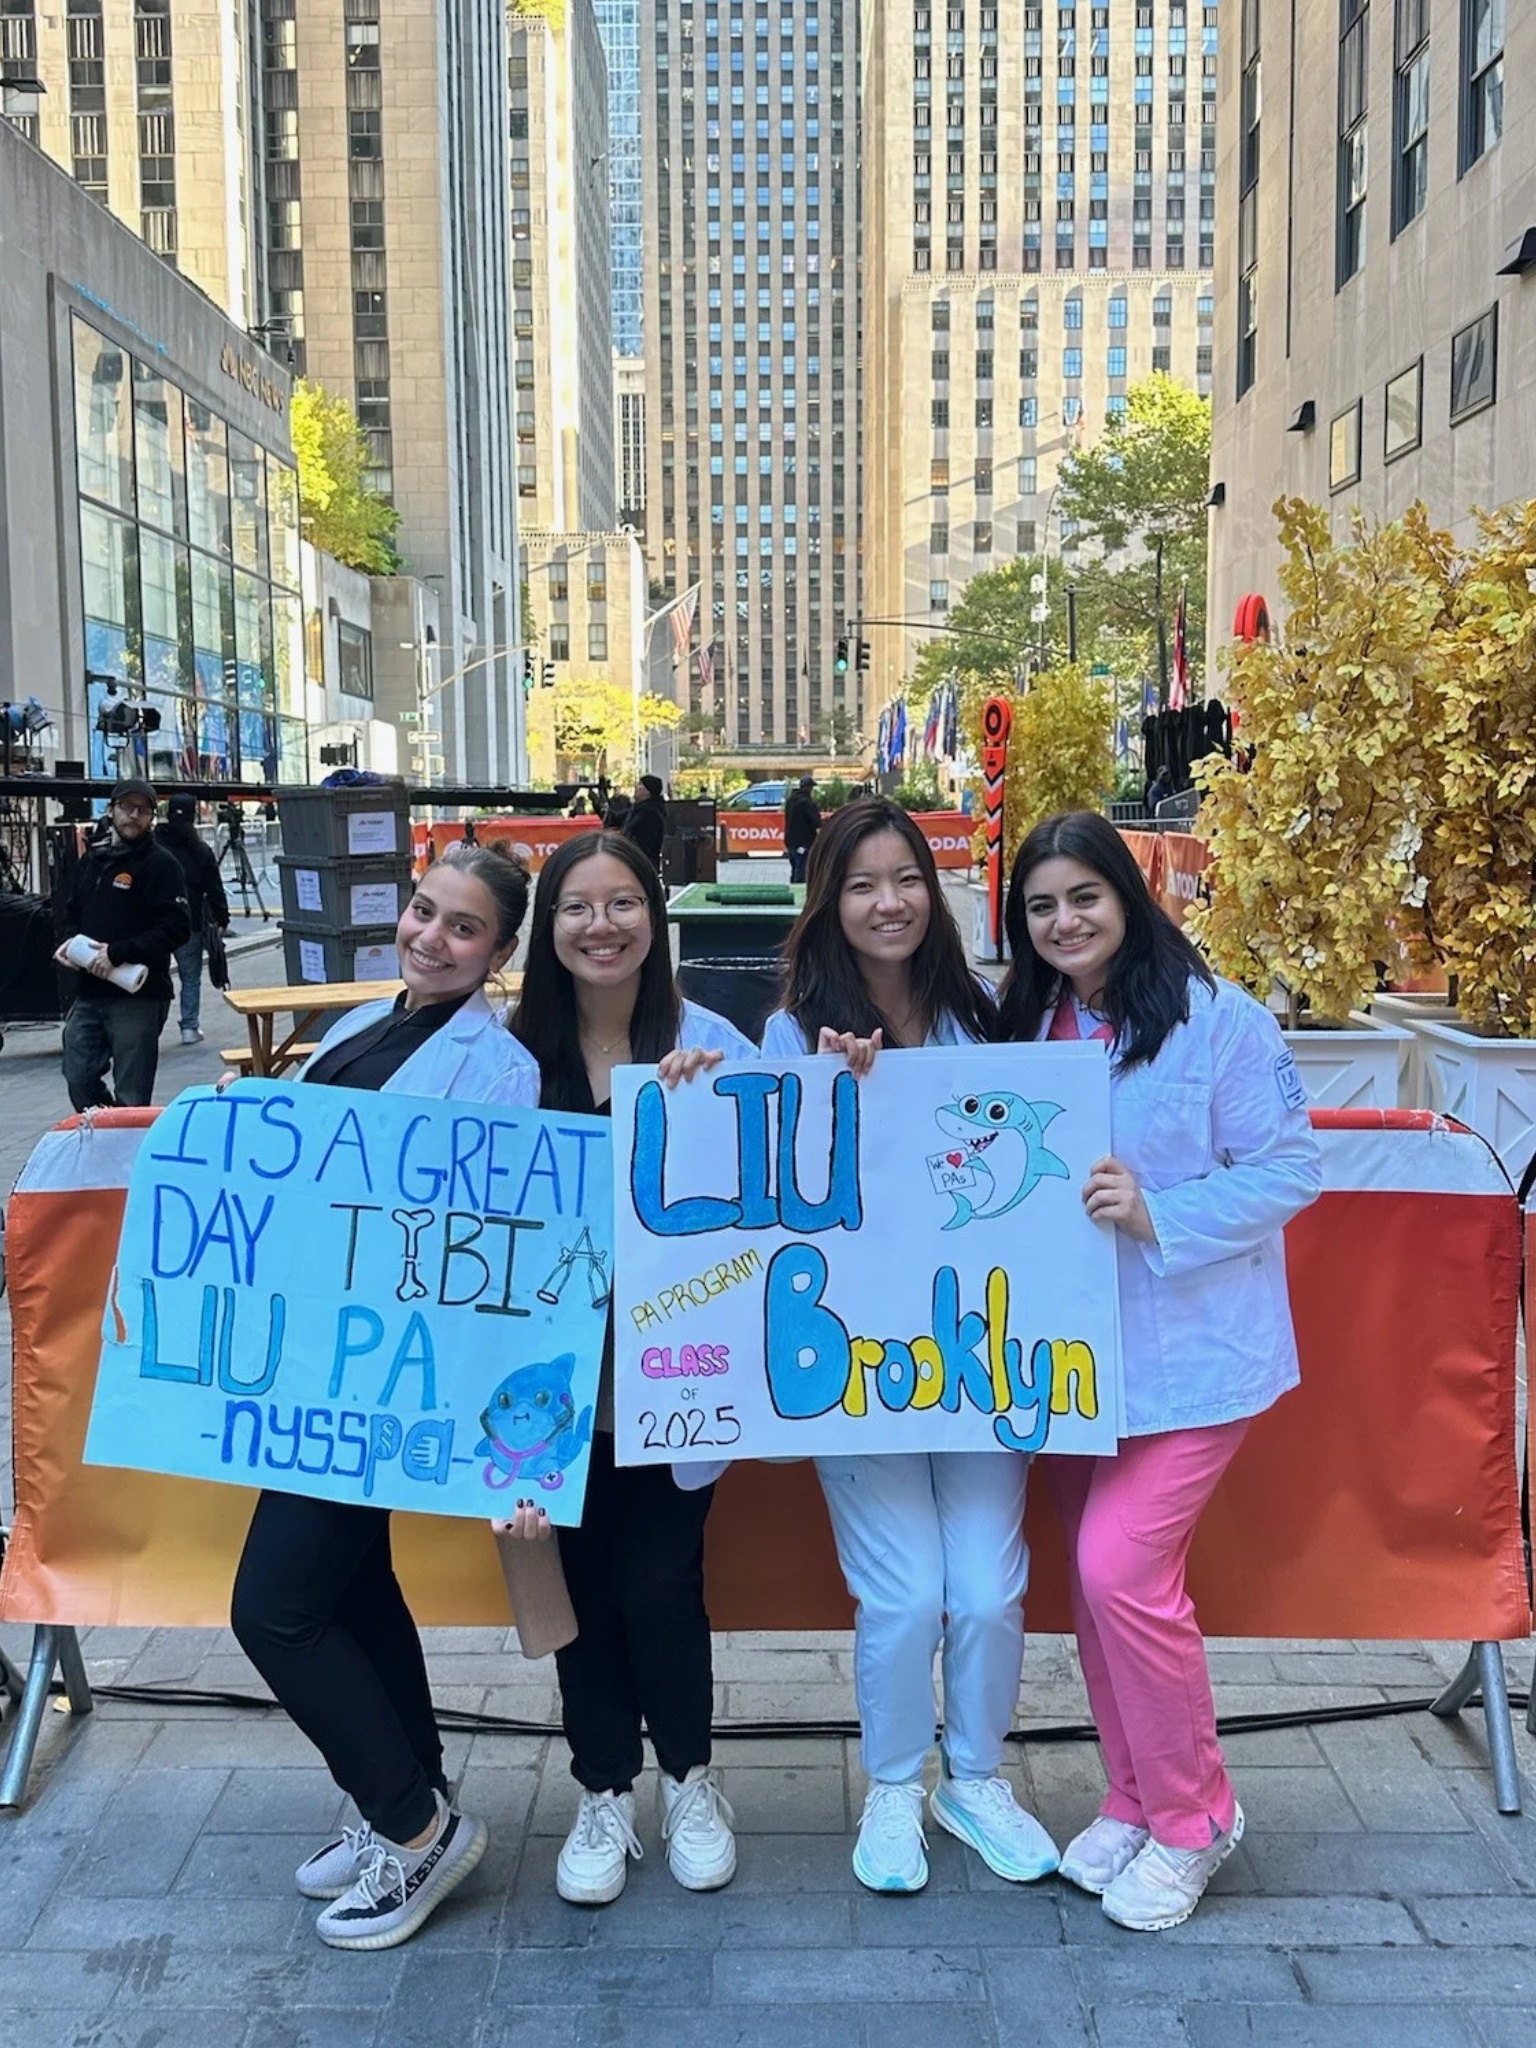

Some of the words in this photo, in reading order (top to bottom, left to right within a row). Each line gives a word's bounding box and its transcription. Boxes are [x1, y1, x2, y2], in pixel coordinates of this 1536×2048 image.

[315, 1107, 374, 1194] A
[399, 1114, 607, 1217] GREAT
[630, 1070, 863, 1237] LIU
[941, 1171, 966, 1188] PAs
[151, 1184, 275, 1287] DAY
[630, 1300, 663, 1334] PA
[657, 1248, 765, 1320] PROGRAM
[140, 1278, 286, 1396] LIU
[327, 1304, 451, 1412] P.A.
[640, 1343, 730, 1379] CLASS
[764, 1242, 1099, 1453] Brooklyn
[638, 1405, 742, 1450] 2025
[680, 1387, 700, 1401] OF
